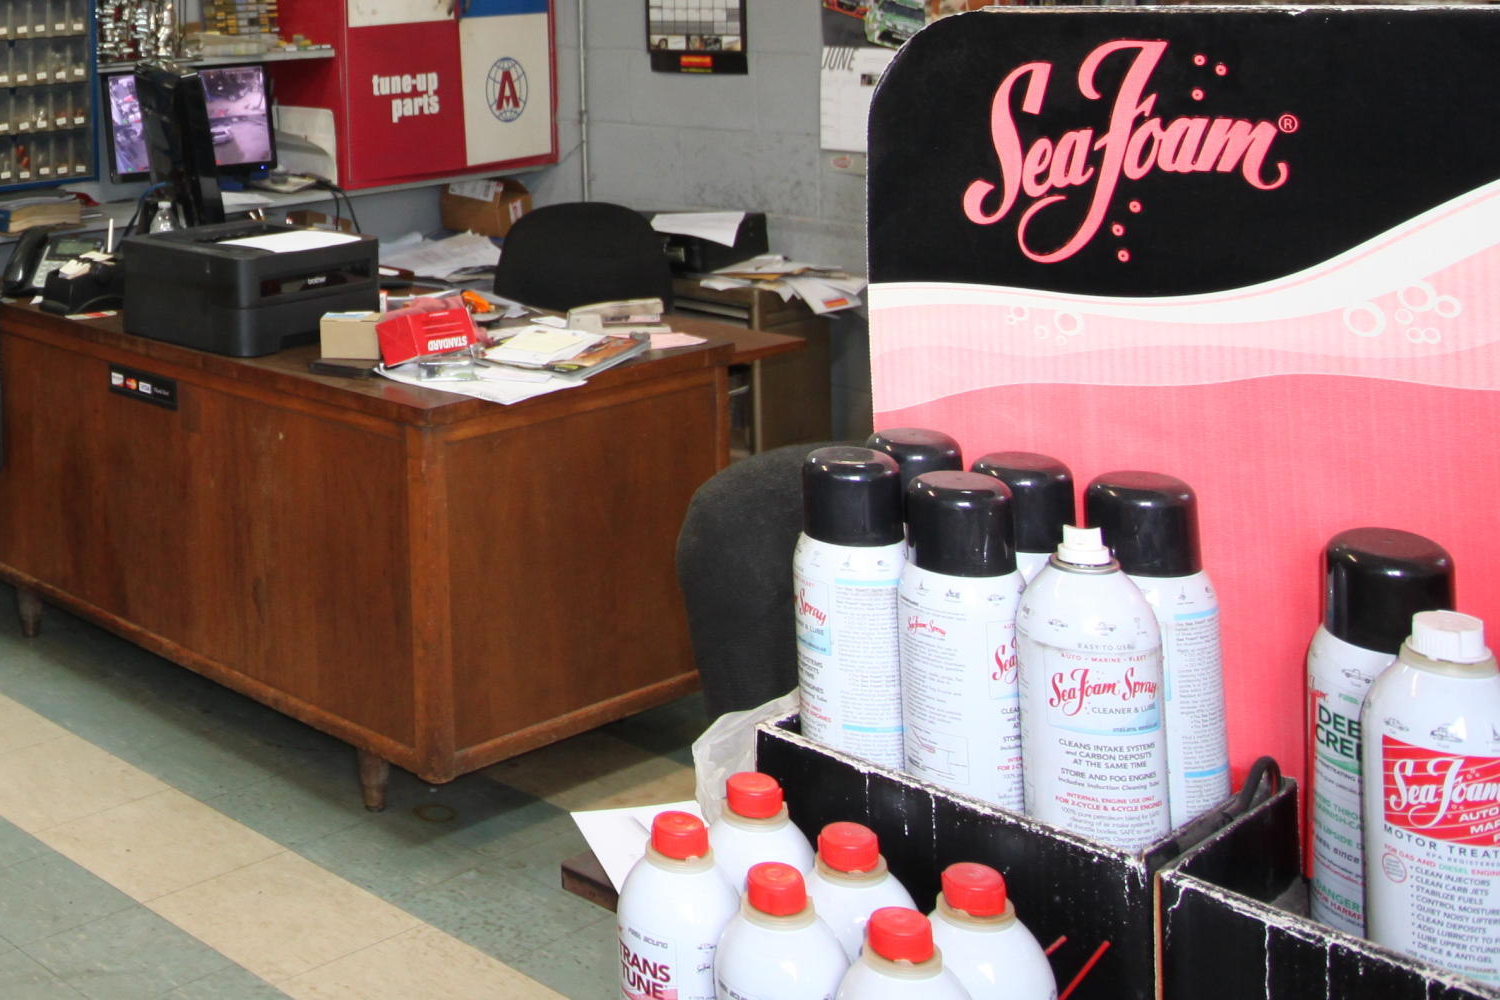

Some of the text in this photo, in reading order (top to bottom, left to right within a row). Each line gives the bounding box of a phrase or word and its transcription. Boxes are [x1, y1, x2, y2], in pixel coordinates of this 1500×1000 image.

[821, 47, 858, 71] JUNE
[372, 72, 438, 96] tune-up
[392, 96, 440, 123] parts
[427, 335, 468, 352] STANDARD
[799, 588, 827, 626] Spray
[1061, 653, 1082, 661] AUTO
[1122, 667, 1157, 701] Spray
[1091, 706, 1132, 715] CLEANER
[1059, 738, 1156, 753] CLEANS INTAKE SYSTEMS
[1079, 751, 1116, 761] CARBON
[1118, 751, 1152, 761] DEPOSITS
[1060, 767, 1086, 779] STORE
[1088, 773, 1107, 781] AND
[1128, 771, 1157, 781] ENGINES
[1086, 760, 1101, 768] THE
[1130, 760, 1147, 768] TIME
[1066, 791, 1099, 803] INTERNAL
[1459, 806, 1500, 823] AUTO
[1384, 823, 1500, 859] MOTOR TREAT
[1399, 850, 1415, 862] GAS
[1418, 857, 1436, 868] AND
[1439, 862, 1468, 875] DIESEL
[1471, 868, 1500, 877] ENGIN
[1415, 864, 1491, 887] CLEAN INJECTORS
[1415, 875, 1489, 897] CLEAN CARB JETS
[1415, 885, 1483, 906] STABILIZE FUELS
[1415, 894, 1456, 911] CONTROL
[1416, 903, 1441, 916] QUIET
[1443, 911, 1470, 924] NOISY
[1416, 912, 1487, 935] CLEAN DEPOSITS
[1416, 922, 1493, 944] ADD LUBRICITY TO
[1417, 931, 1500, 955] LUBE UPPER CYLIND
[619, 937, 671, 983] TRANS
[1455, 951, 1493, 964] ANTI-GEL
[621, 959, 664, 1000] TUNE
